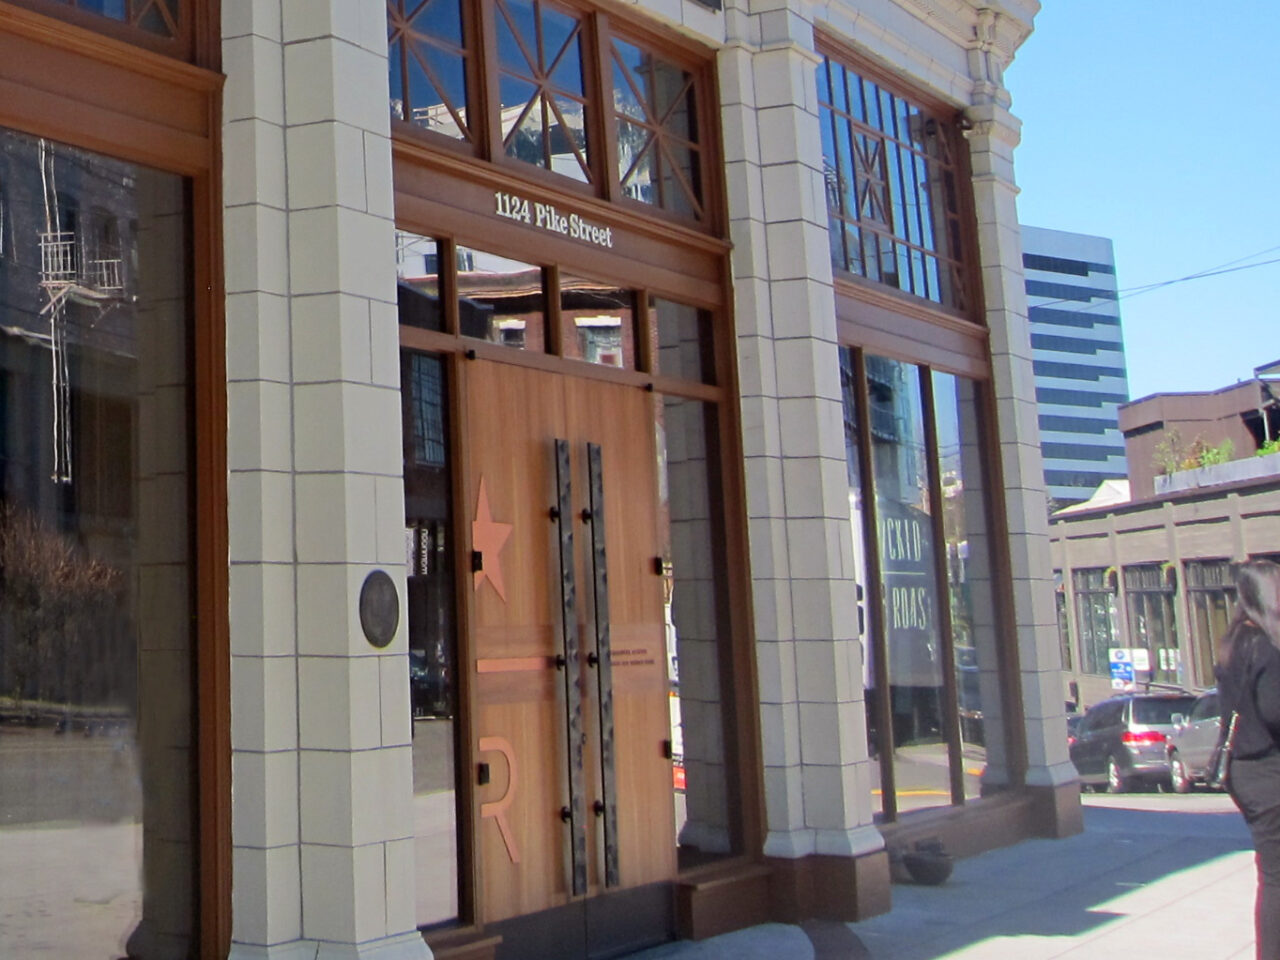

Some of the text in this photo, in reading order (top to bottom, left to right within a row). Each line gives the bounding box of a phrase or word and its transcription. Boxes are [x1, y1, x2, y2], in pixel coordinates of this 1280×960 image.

[494, 192, 613, 248] 1124 Pike Street
